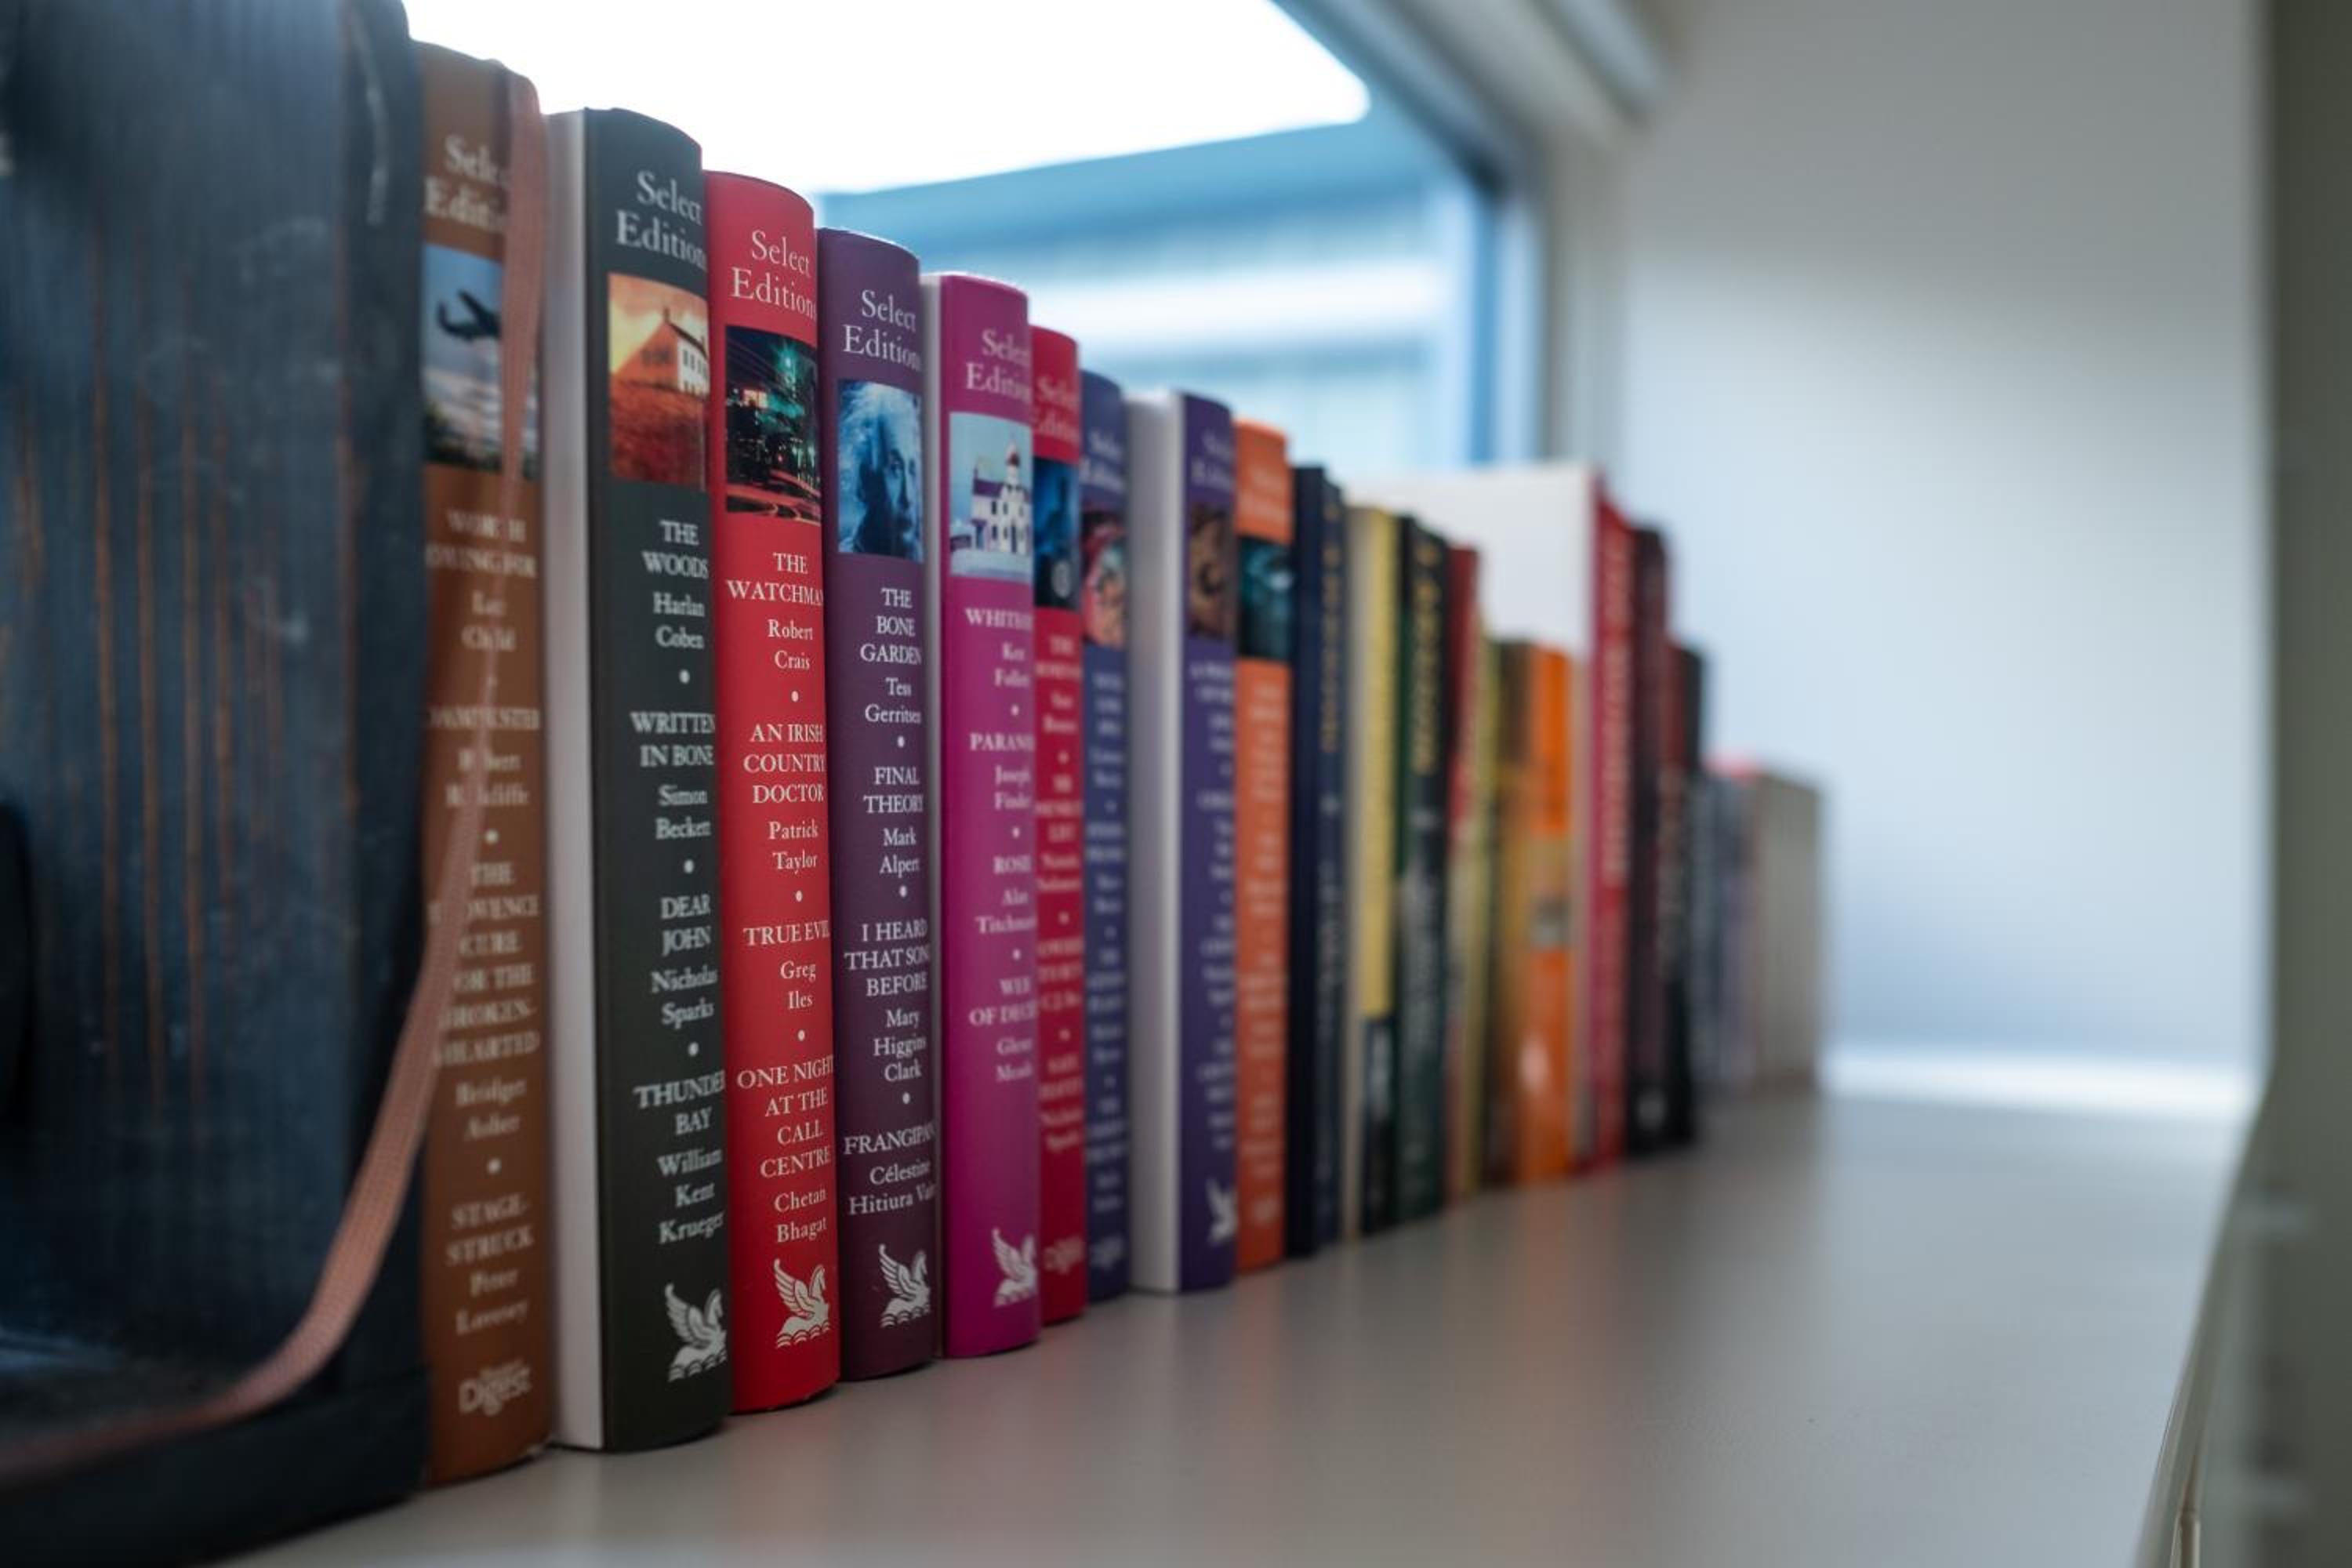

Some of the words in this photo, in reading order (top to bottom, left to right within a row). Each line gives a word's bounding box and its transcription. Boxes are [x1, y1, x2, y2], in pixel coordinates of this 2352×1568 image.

[637, 169, 702, 227] Select
[616, 209, 708, 273] Edition
[751, 229, 811, 278] Select
[729, 267, 816, 322] Edition
[861, 289, 916, 332] Select
[842, 324, 919, 372] Edition
[659, 520, 699, 546] THE
[641, 551, 709, 580] WOODS
[773, 552, 808, 575] THE
[653, 592, 705, 617] Harlan
[881, 587, 913, 608] THE
[767, 619, 813, 641] Robert
[877, 615, 916, 637] BONE
[774, 650, 810, 670] Crais
[860, 643, 921, 665] GARDEN
[885, 677, 912, 696] Tess
[750, 724, 783, 742] AN
[788, 724, 823, 742] IRISH
[640, 746, 668, 768] IN
[672, 746, 714, 767] BONE
[874, 766, 920, 786] FINAL
[753, 784, 823, 804] DOCTOR
[768, 819, 818, 840] Patrick
[884, 826, 916, 846] Mark
[772, 849, 818, 875] Taylor
[879, 854, 920, 878] Alpert
[660, 894, 711, 920] DEAR
[662, 926, 712, 957] JOHN
[742, 924, 801, 946] TRUE
[805, 920, 829, 940] EVIL
[862, 923, 869, 942] I
[876, 917, 928, 941] HEARD
[844, 948, 903, 971] THAT
[906, 943, 930, 966] SON
[780, 960, 816, 982] Greg
[866, 971, 927, 996] BEFORE
[789, 991, 813, 1010] Iles
[661, 997, 715, 1030] Sparks
[886, 1007, 920, 1029] Mary
[968, 1007, 996, 1028] OF
[736, 1065, 789, 1091] ONE
[794, 1054, 834, 1083] NIGHT
[884, 1058, 922, 1082] Clark
[632, 1070, 726, 1109] THUNDE
[764, 1095, 794, 1117] AT
[798, 1087, 827, 1112] THE
[676, 1106, 713, 1136] BAY
[777, 1120, 824, 1145] CALL
[760, 1145, 831, 1178] CENTRE
[675, 1183, 716, 1208] Kent
[774, 1185, 826, 1214] Chetan
[850, 1192, 913, 1214] Hitiura
[659, 1212, 725, 1245] Krueger
[777, 1217, 827, 1243] Bhagat
